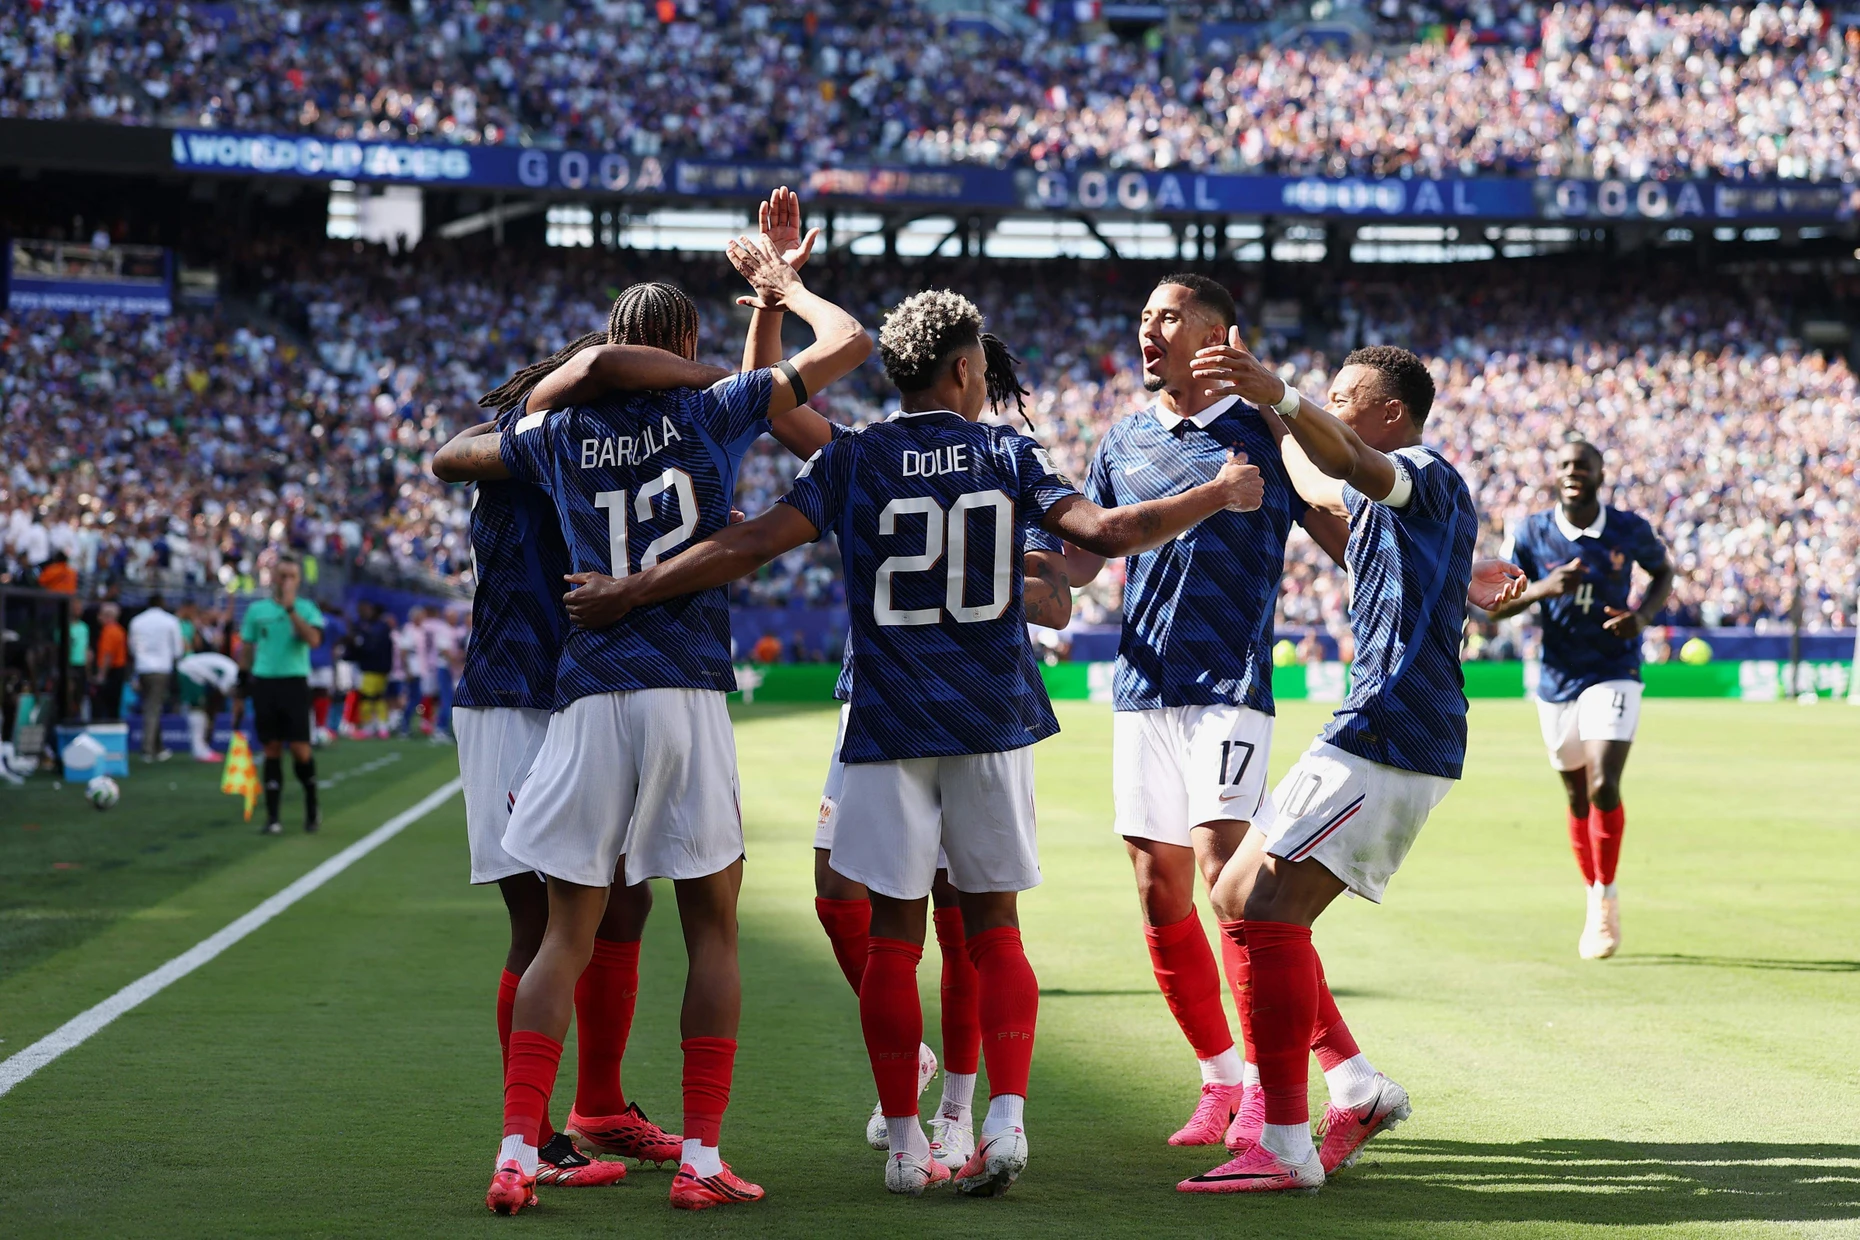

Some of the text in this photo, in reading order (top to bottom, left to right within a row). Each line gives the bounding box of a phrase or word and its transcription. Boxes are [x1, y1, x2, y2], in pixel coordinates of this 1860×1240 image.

[903, 443, 969, 478] DOUE
[594, 466, 700, 579] 12
[873, 489, 1015, 626] 20
[1574, 583, 1595, 616] 4
[1611, 691, 1627, 718] 4
[1218, 740, 1256, 785] 17
